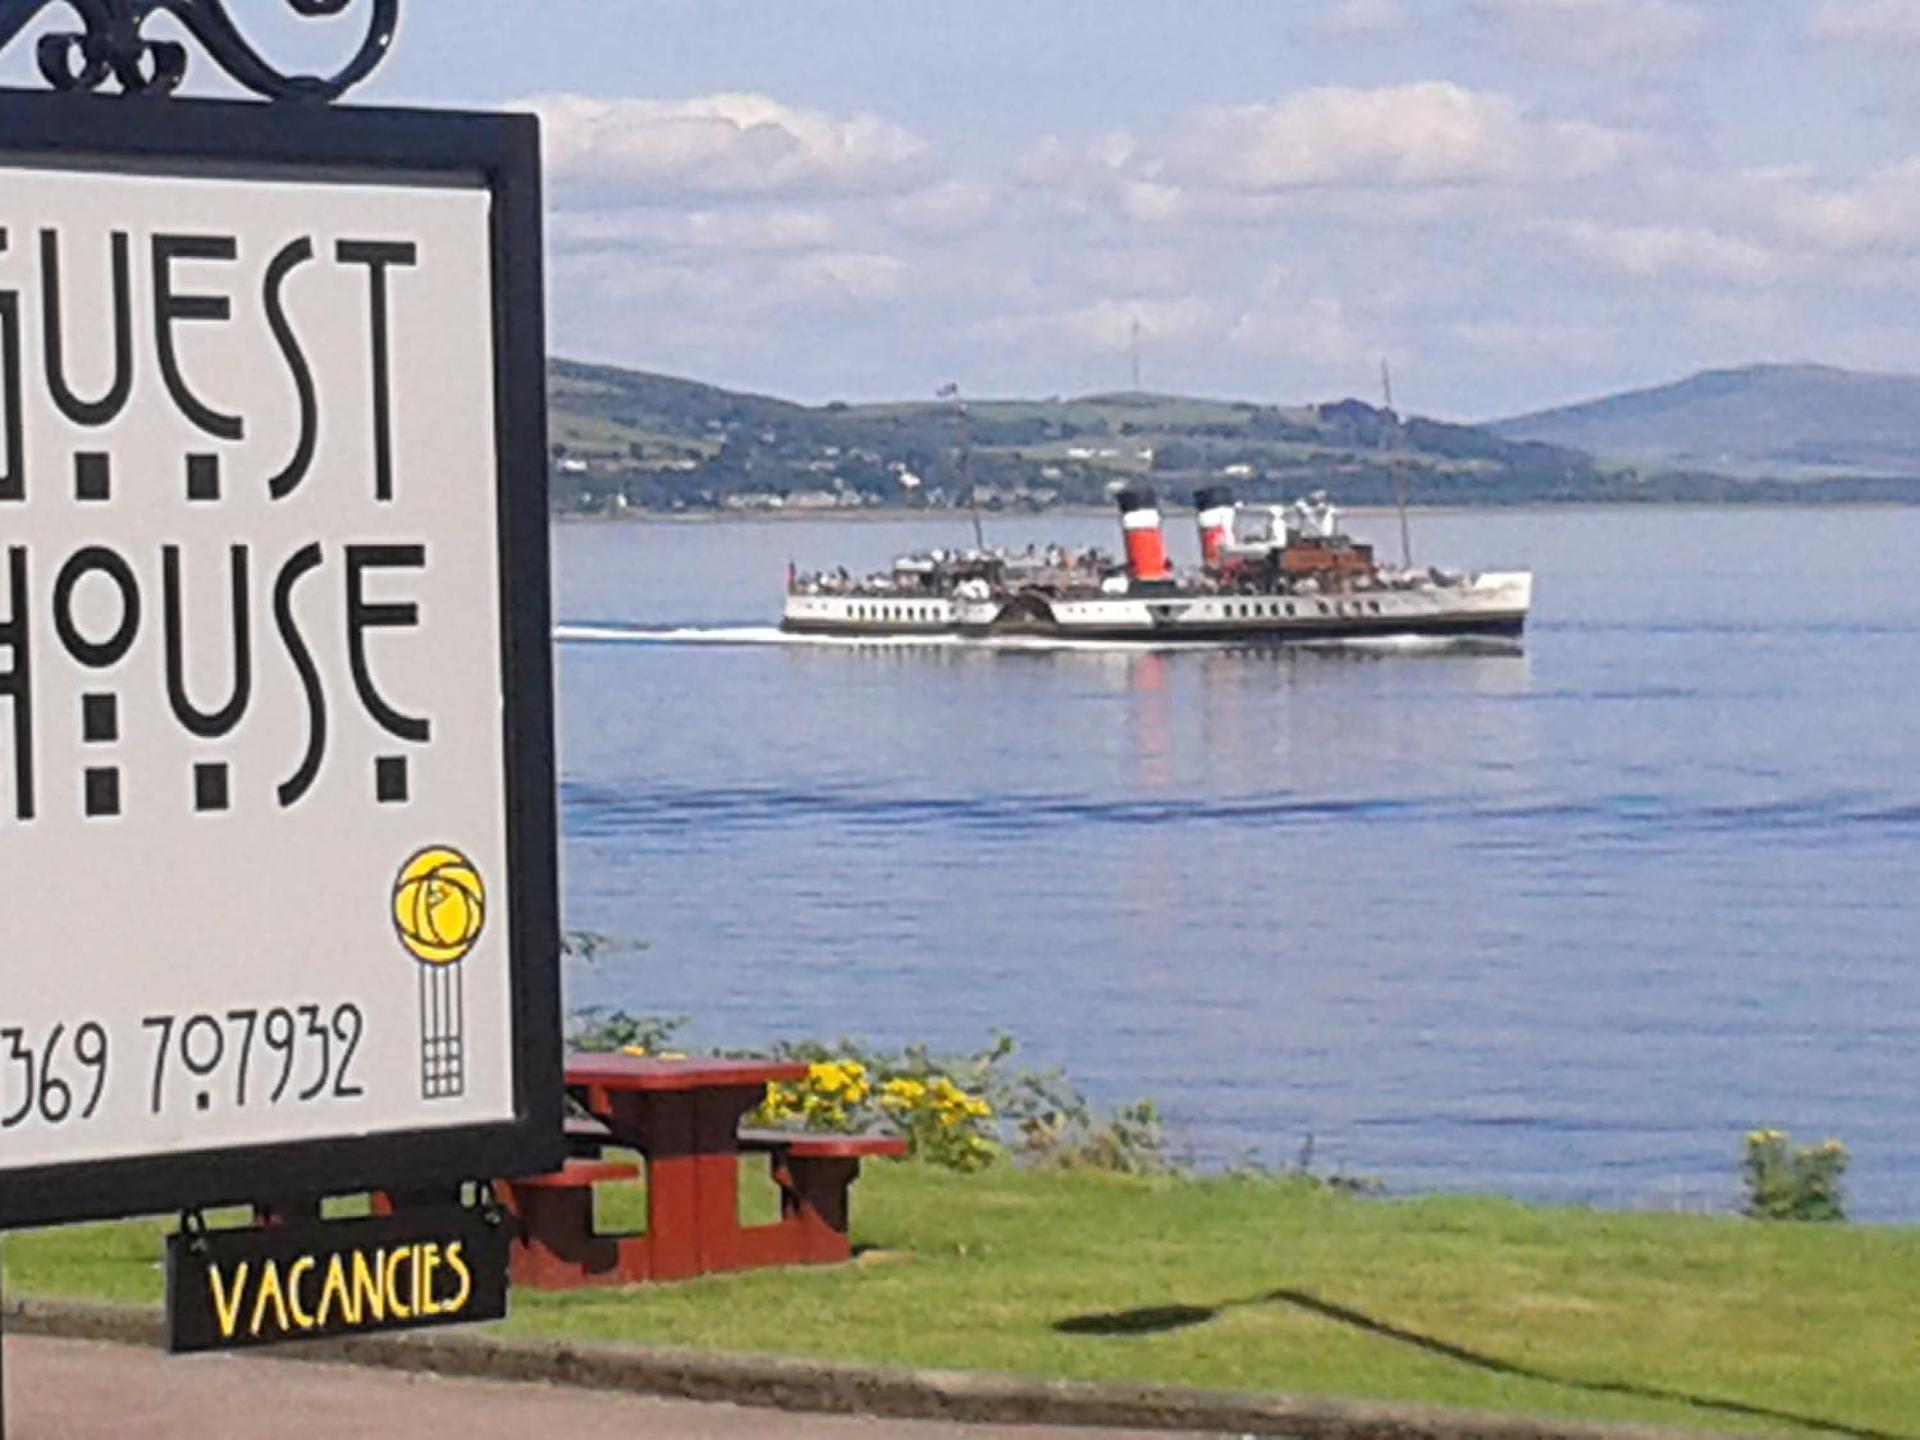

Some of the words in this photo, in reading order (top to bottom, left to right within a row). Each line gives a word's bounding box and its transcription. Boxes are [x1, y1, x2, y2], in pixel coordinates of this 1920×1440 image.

[1, 1021, 108, 1127] 369
[142, 1002, 363, 1114] 707932
[208, 1240, 471, 1337] VACANCIES
